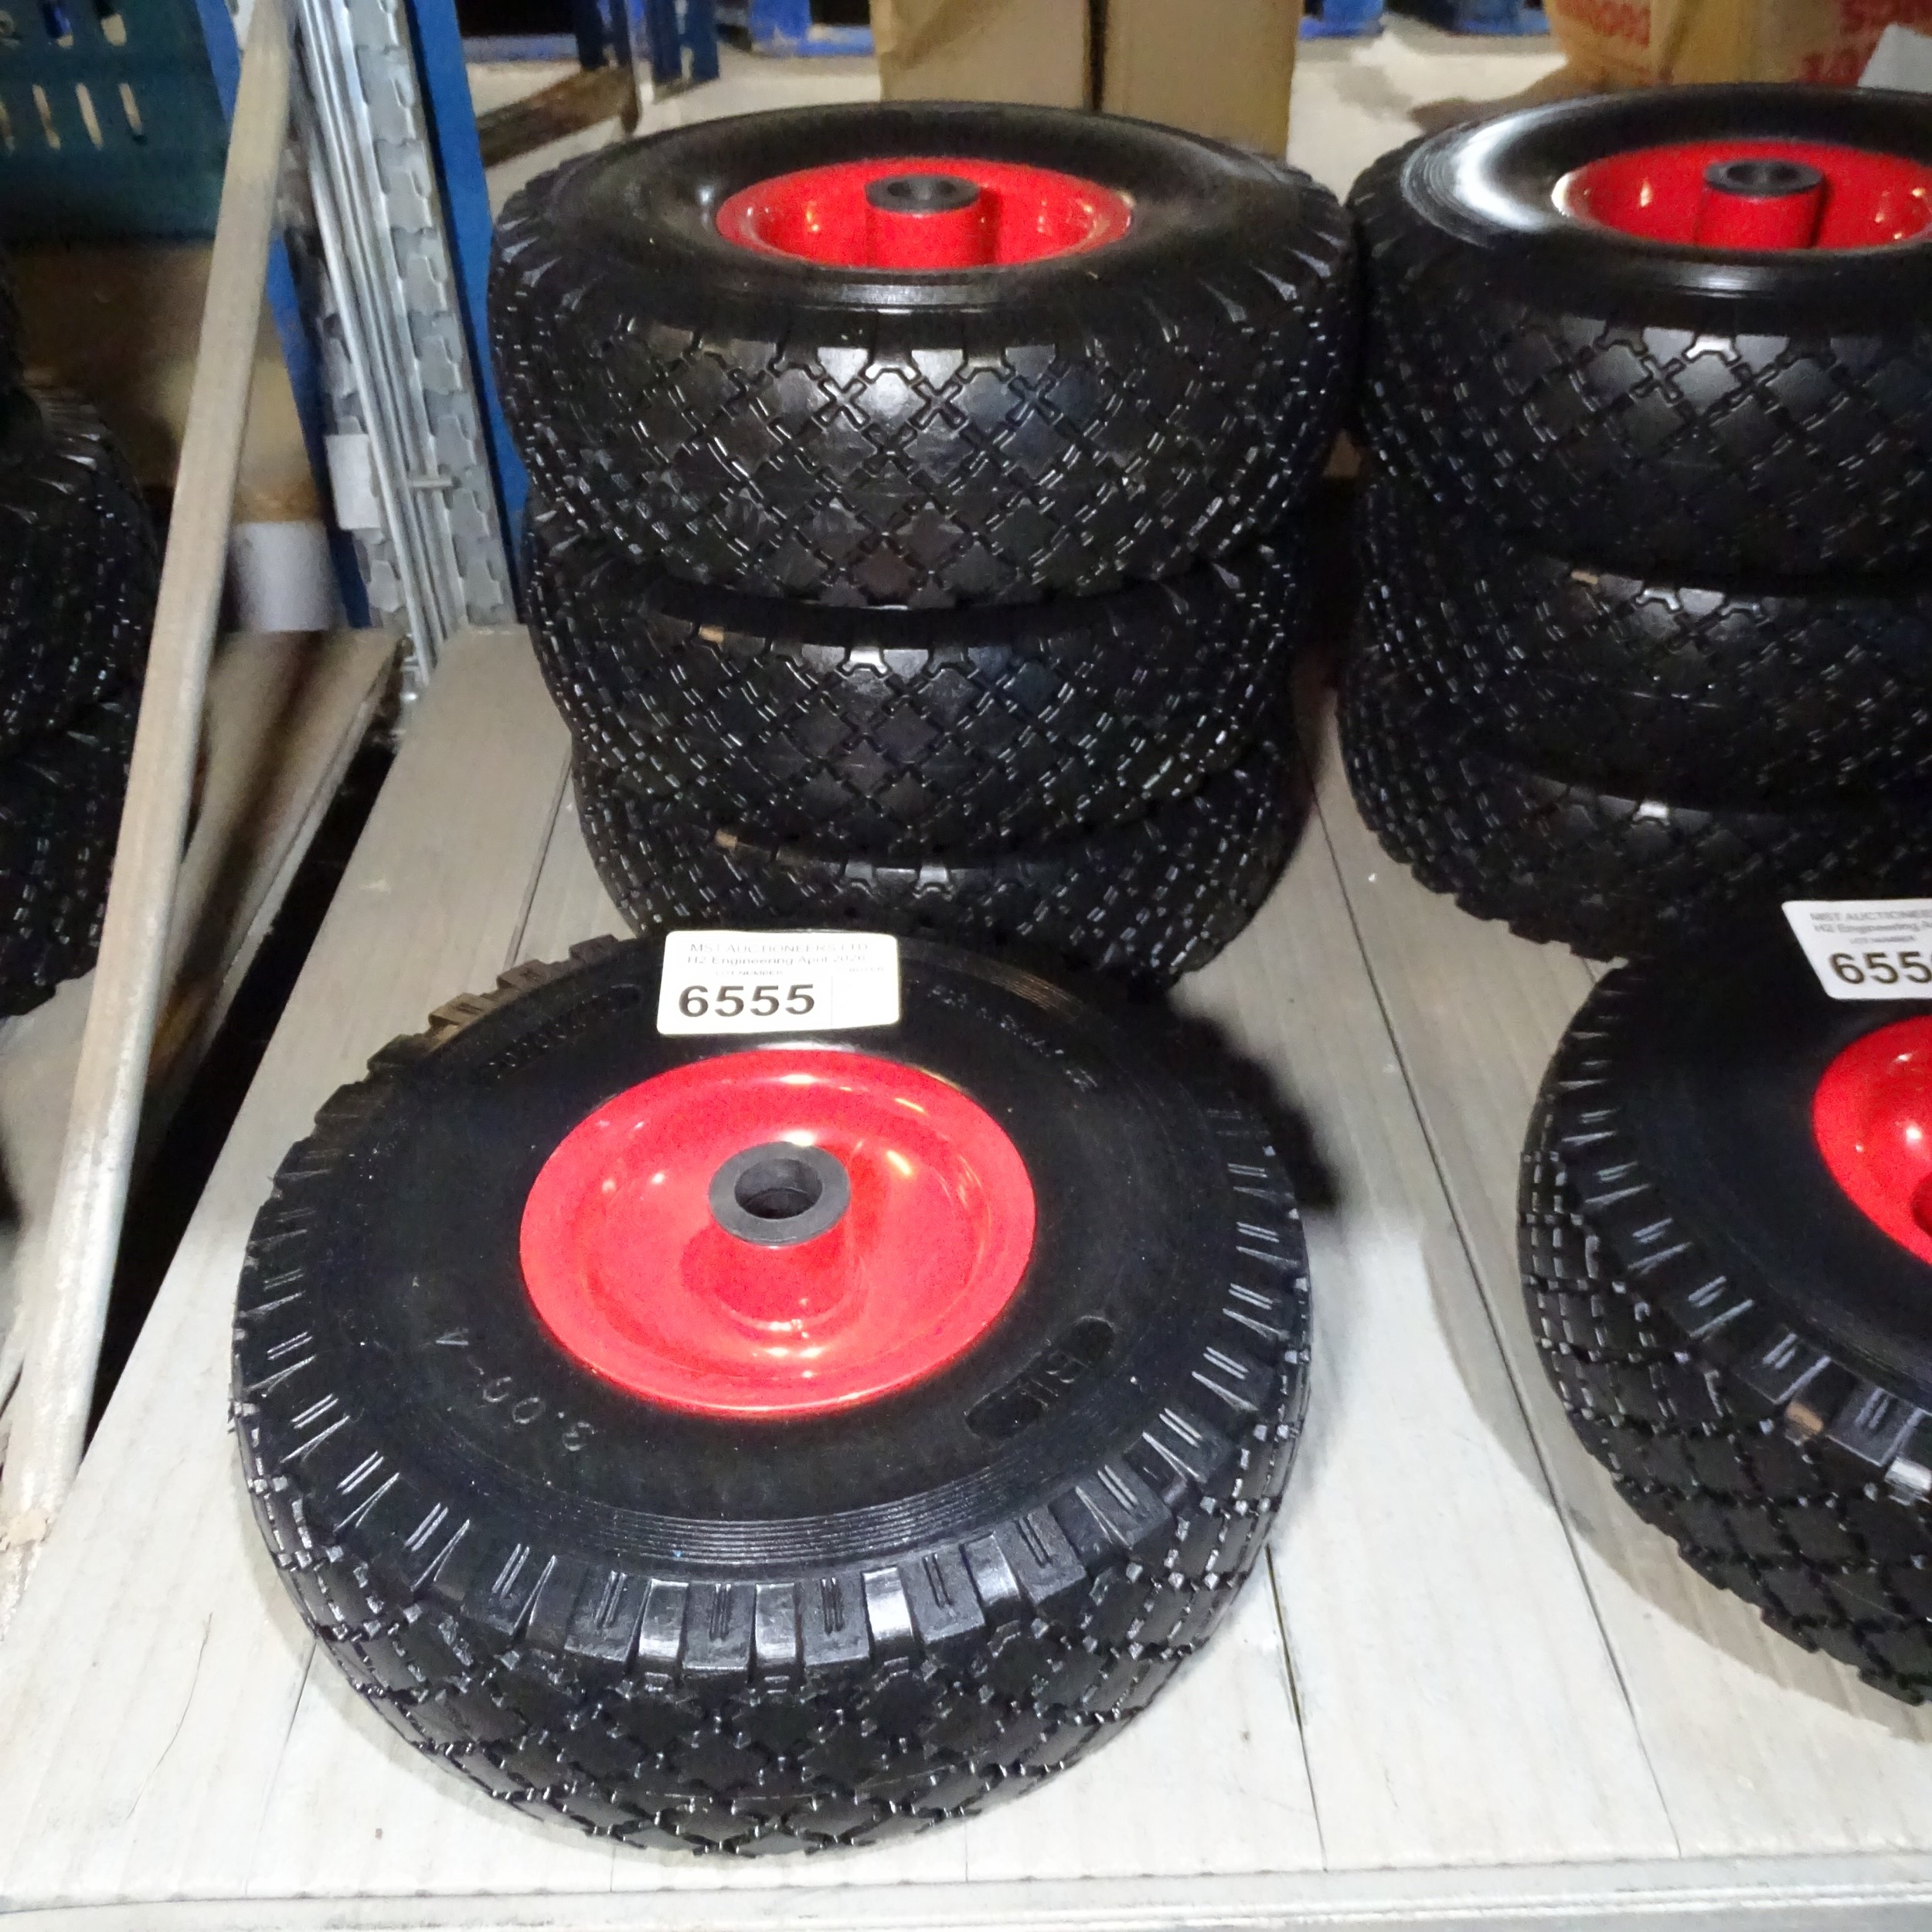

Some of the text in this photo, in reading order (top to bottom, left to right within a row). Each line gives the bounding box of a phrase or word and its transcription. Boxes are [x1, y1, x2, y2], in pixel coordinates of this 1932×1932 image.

[690, 943, 721, 953] MST
[726, 943, 836, 953] AUCTIONEERS
[687, 955, 706, 964] H2
[712, 955, 793, 966] Engineering
[798, 954, 828, 966] April
[1828, 951, 1932, 985] 655
[679, 984, 815, 1018] 6555
